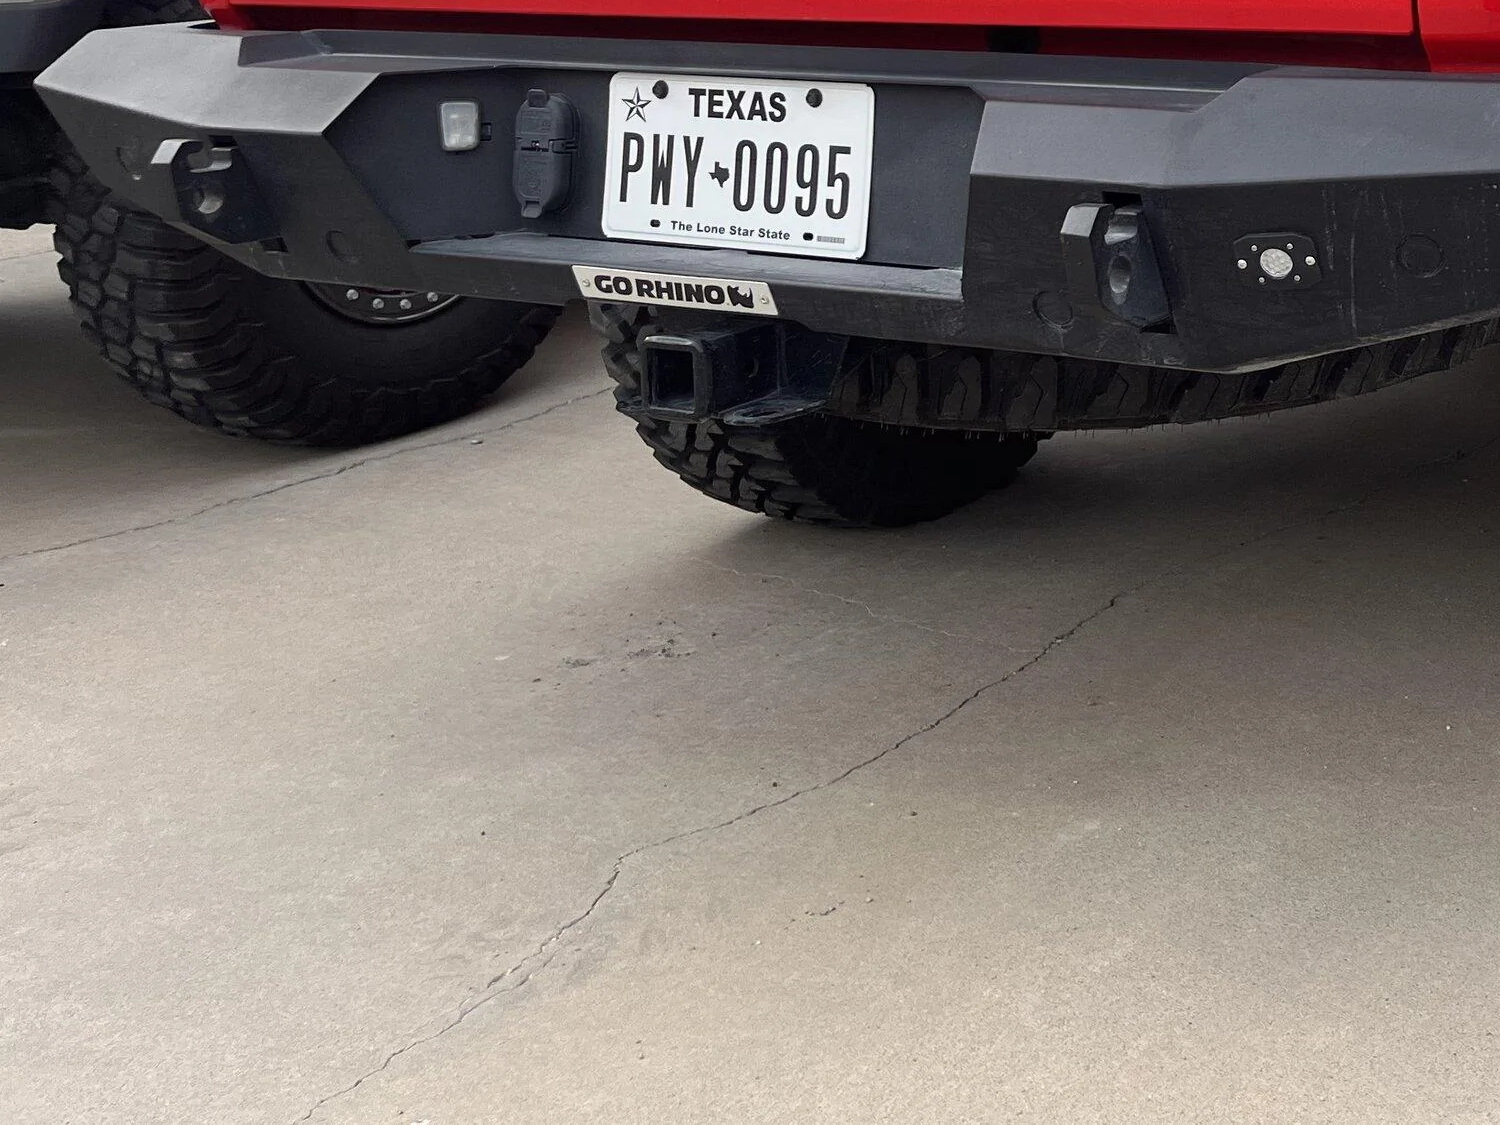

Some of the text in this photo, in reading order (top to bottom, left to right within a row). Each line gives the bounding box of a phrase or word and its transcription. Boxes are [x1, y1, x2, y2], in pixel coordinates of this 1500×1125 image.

[688, 87, 787, 122] TEXAS
[671, 220, 790, 240] The Lone Star State
